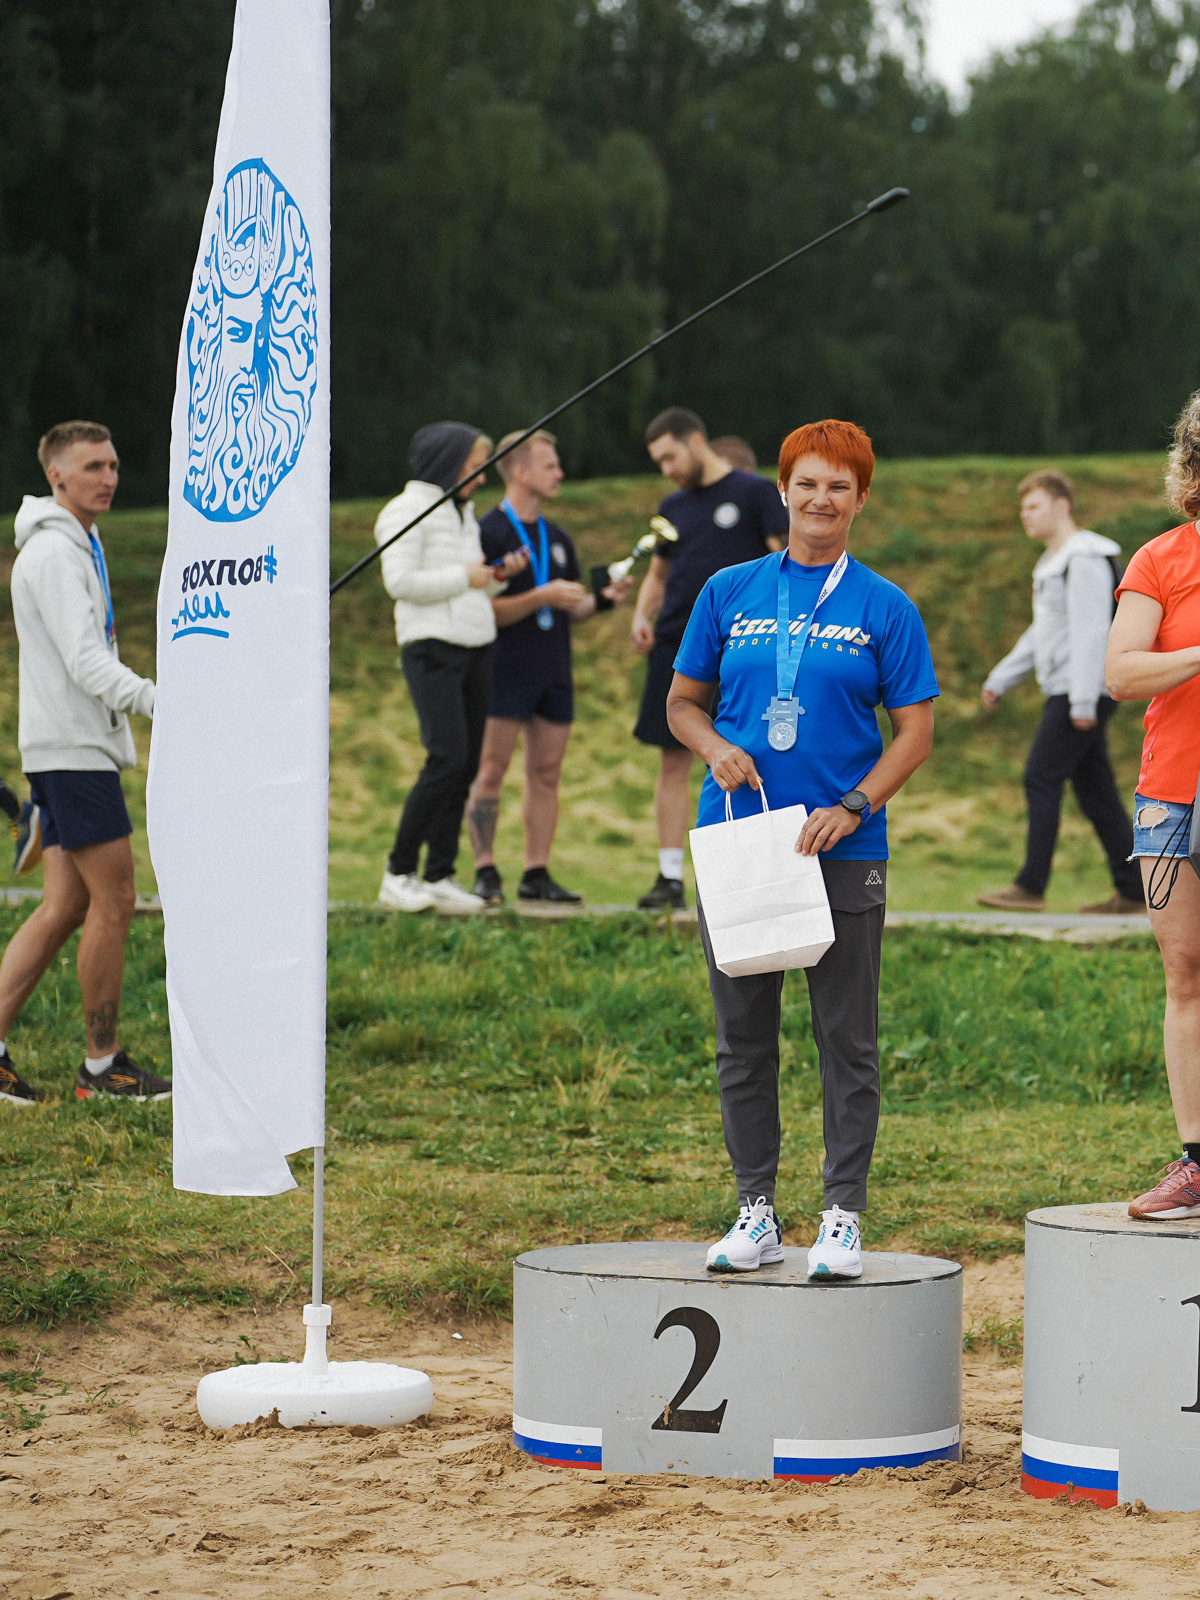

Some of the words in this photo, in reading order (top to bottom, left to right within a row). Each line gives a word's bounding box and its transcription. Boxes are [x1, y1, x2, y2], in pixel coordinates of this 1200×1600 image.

[728, 637, 796, 649] Spors
[809, 638, 859, 656] Team
[651, 1306, 728, 1434] 2
